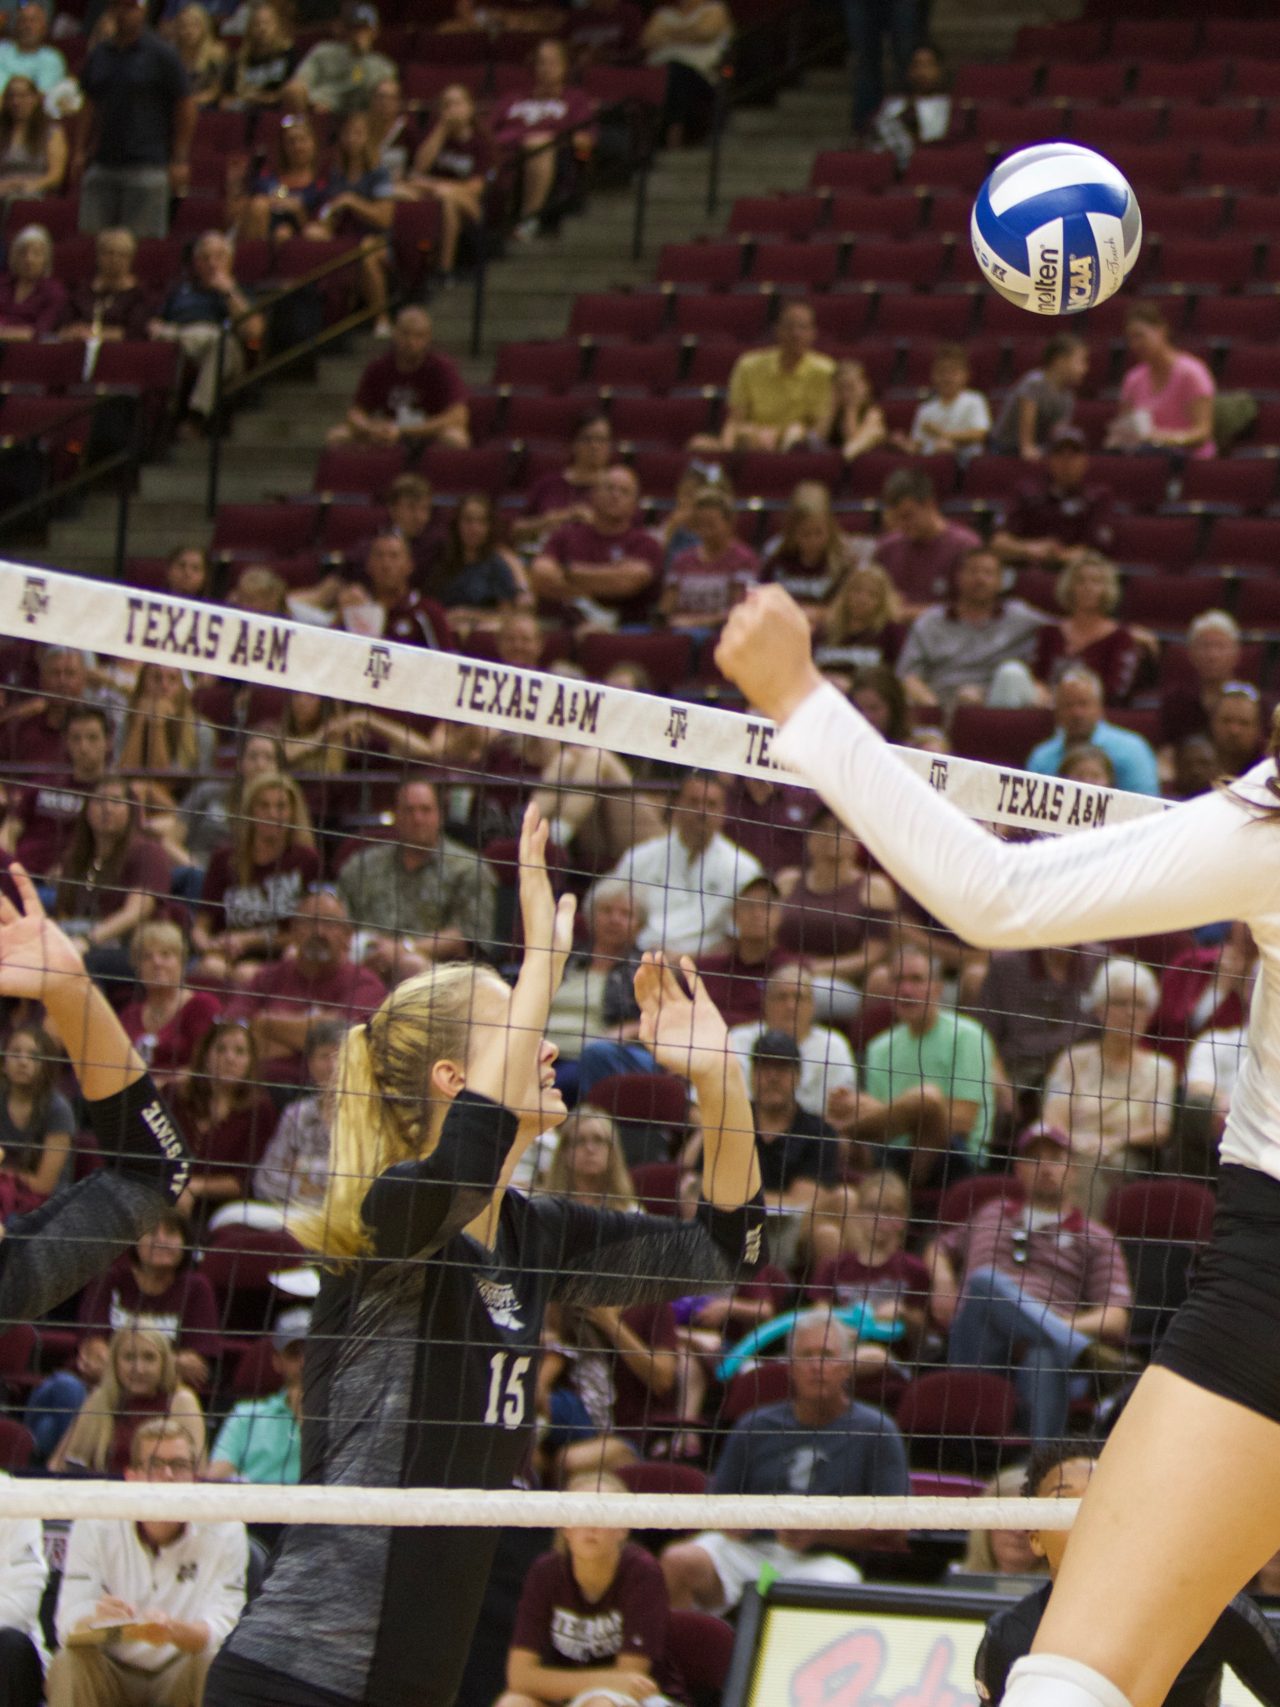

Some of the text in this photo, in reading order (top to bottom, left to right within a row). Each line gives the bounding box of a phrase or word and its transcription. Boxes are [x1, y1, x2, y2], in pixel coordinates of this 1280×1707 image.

[1034, 248, 1059, 312] molten
[1066, 255, 1092, 311] NCAA
[124, 597, 293, 674] TEXAS A&M
[455, 663, 602, 734] TEXAS A&M
[997, 773, 1110, 829] TEXAS A&M
[141, 1101, 183, 1160] STATE
[483, 1351, 532, 1430] 15
